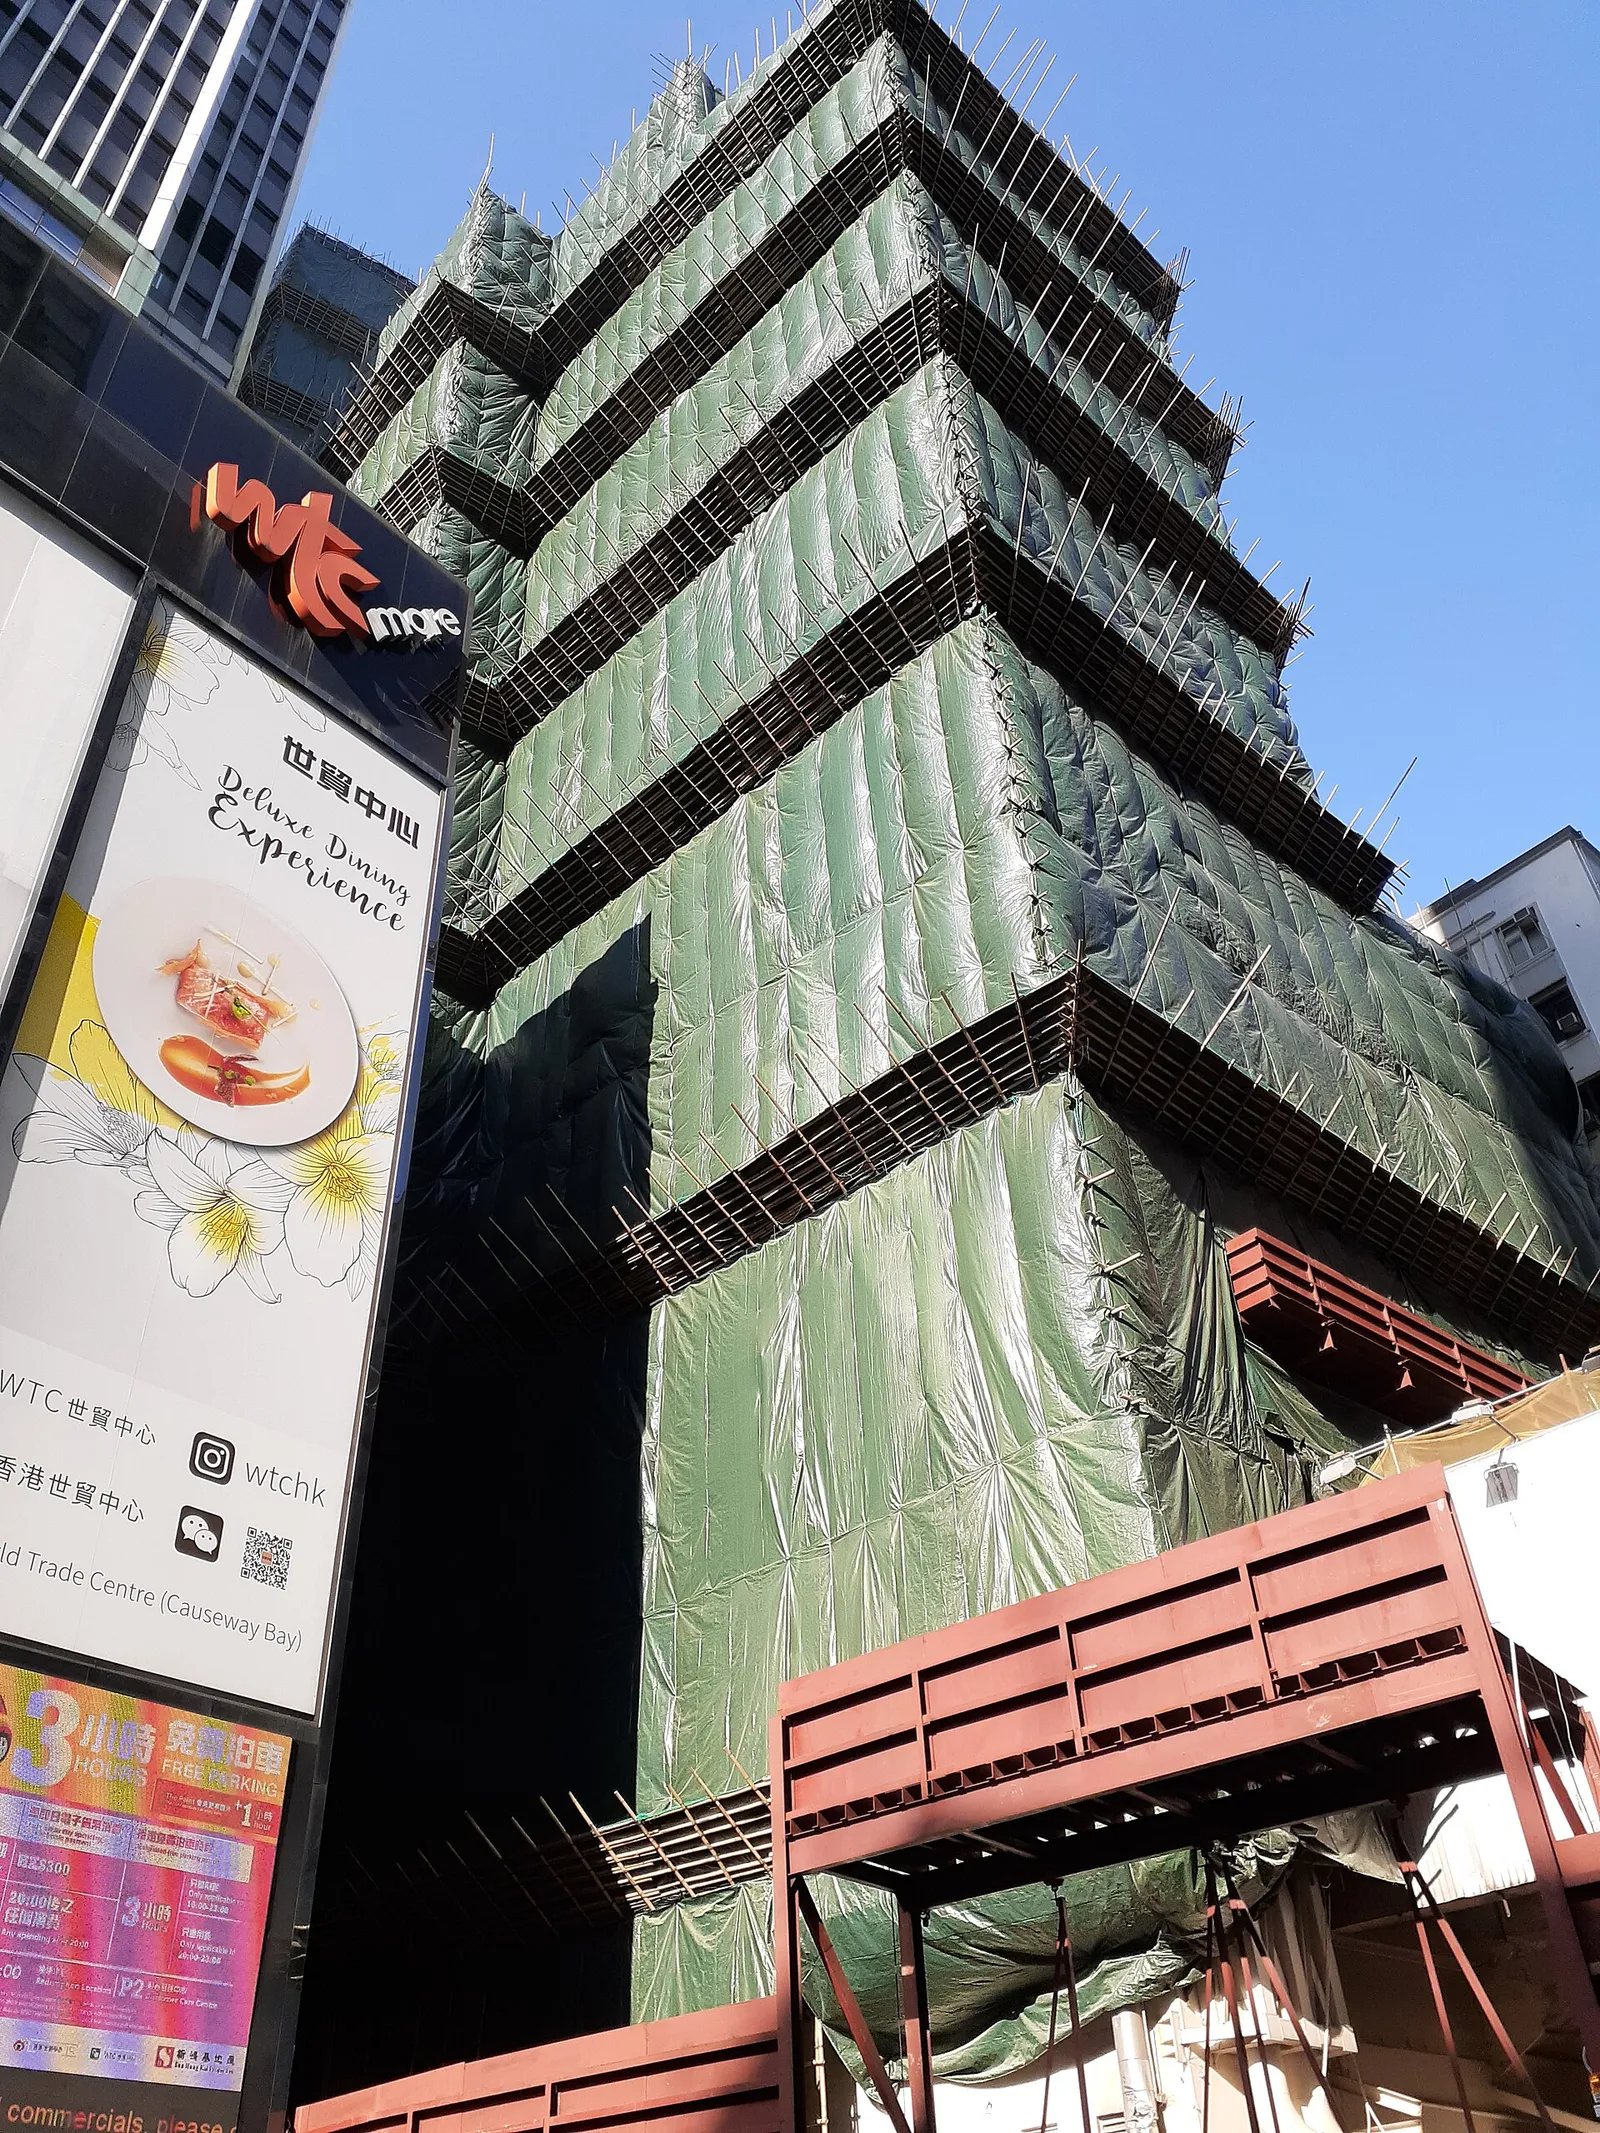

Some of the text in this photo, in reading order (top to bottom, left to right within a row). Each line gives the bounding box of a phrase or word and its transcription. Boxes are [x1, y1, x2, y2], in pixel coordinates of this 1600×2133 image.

[366, 606, 462, 642] more
[283, 735, 420, 850] 世貿中心
[217, 764, 411, 907] Deluxe Dining
[208, 791, 405, 931] Experience
[0, 1369, 156, 1446] WTC 世貿中心
[0, 1455, 146, 1523] 香港世貿中心
[245, 1461, 326, 1508] wtchk
[28, 1551, 85, 1586] Trade
[90, 1571, 155, 1607] Centre
[160, 1590, 260, 1641] (Causeway
[264, 1622, 303, 1653] Bay)
[10, 1689, 285, 1787] 3 小時 免費泊車
[73, 1755, 278, 1798] HOURS FREE PARKING
[253, 1820, 271, 1832] hour
[255, 1809, 273, 1822] 小時
[121, 1895, 172, 1927] 3 小時
[141, 1919, 168, 1933] Hours
[118, 1977, 145, 2000] P2
[157, 2115, 223, 2133] please
